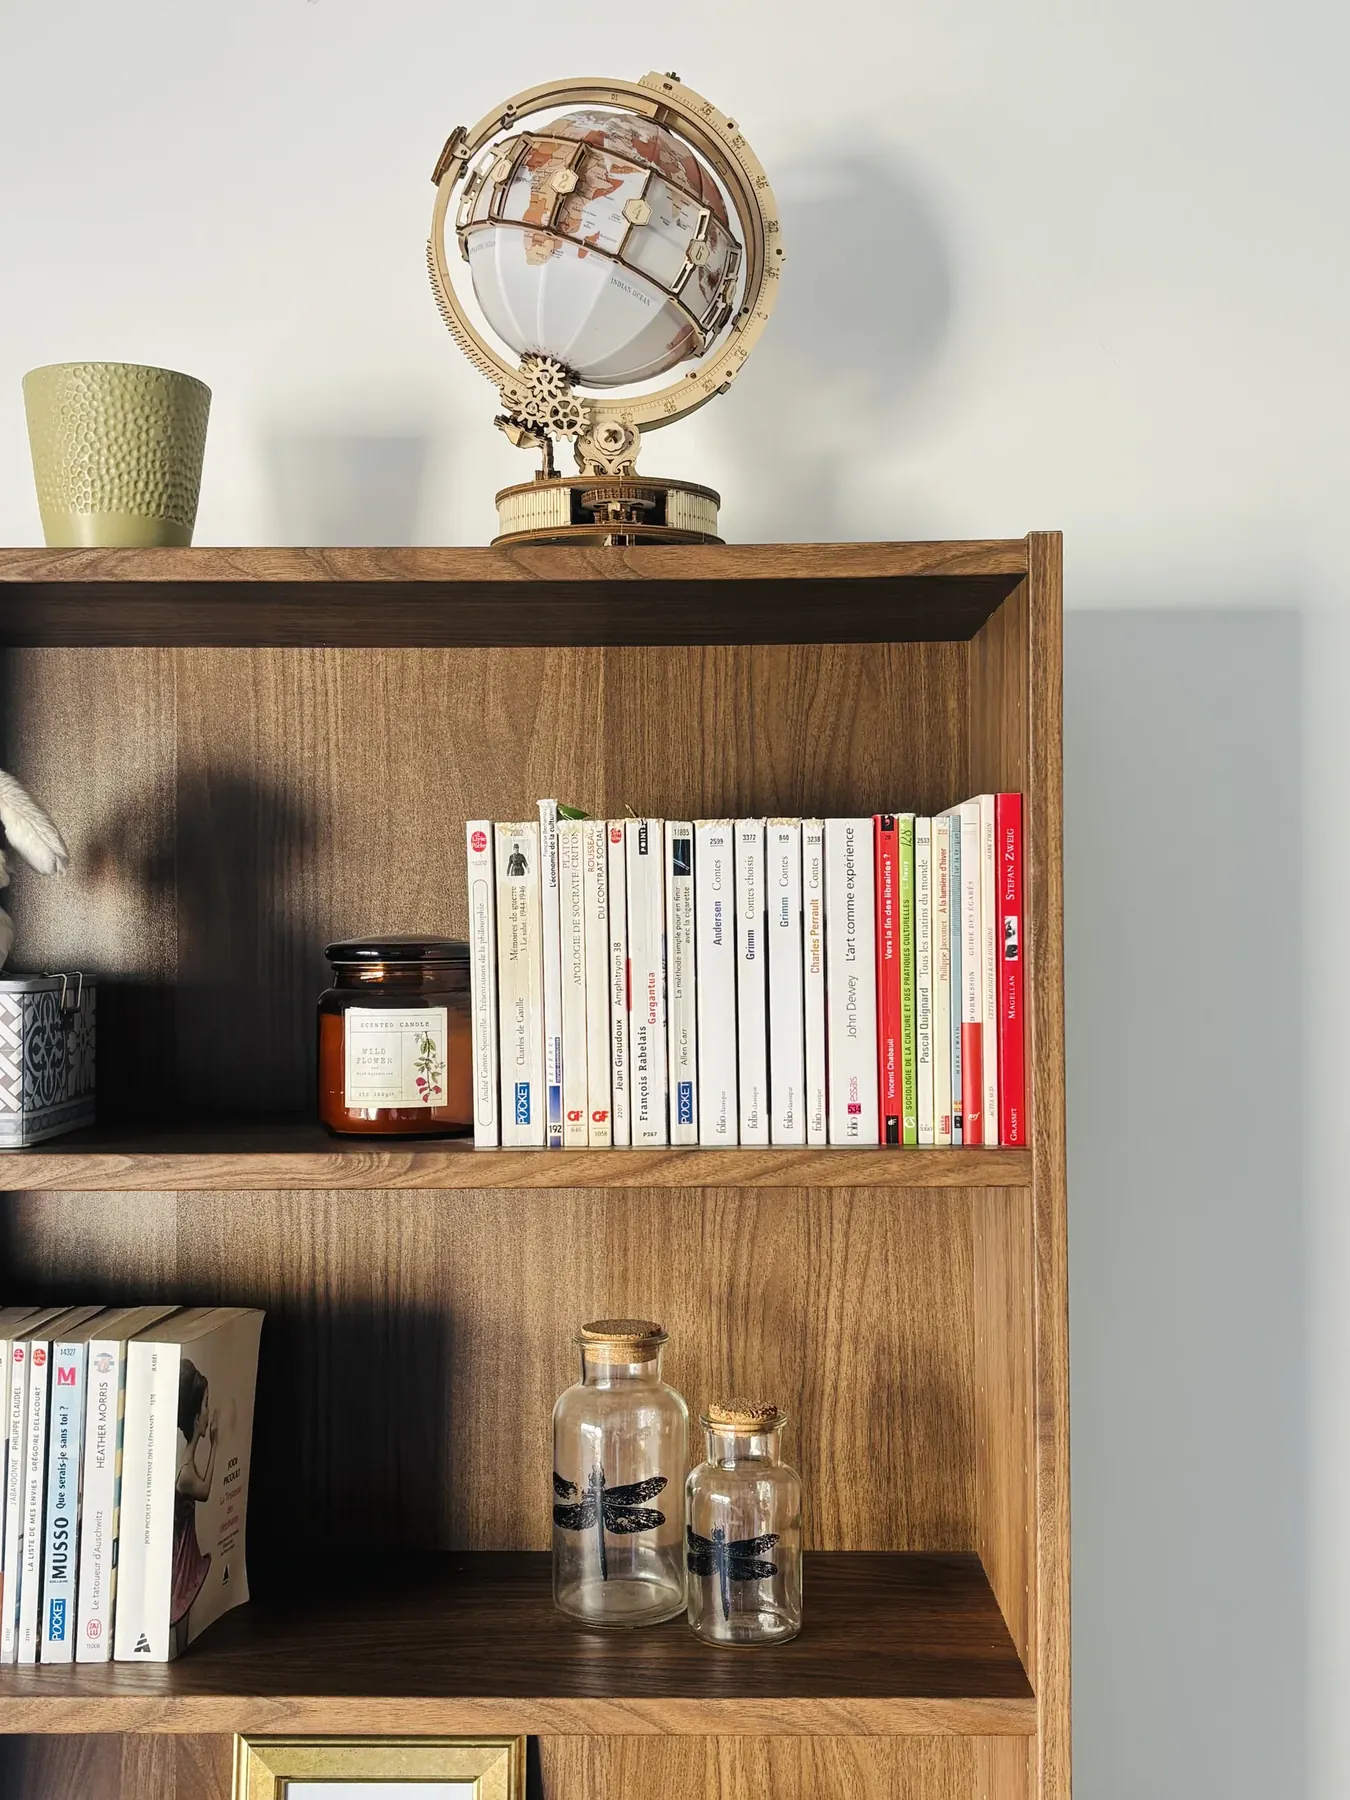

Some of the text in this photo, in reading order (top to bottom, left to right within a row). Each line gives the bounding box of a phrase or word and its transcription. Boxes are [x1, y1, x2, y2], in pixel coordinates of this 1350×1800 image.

[559, 173, 569, 189] 2
[631, 204, 642, 220] 4
[610, 277, 651, 306] INDIAN OCEAN
[900, 829, 912, 847] 128
[549, 851, 557, 887] L'économie
[596, 828, 605, 919] DU CONTRAT SOCIAL
[939, 848, 947, 871] d'hiver
[779, 856, 789, 927] Grimm Contes
[844, 828, 856, 961] L'art comme expérience
[883, 861, 891, 898] librairies
[508, 912, 517, 921] de
[675, 903, 681, 912] en
[683, 887, 691, 917] cigarette
[712, 860, 722, 945] Andersen Contes
[745, 856, 755, 960] Grimm Contes choisis
[809, 857, 819, 974] Charles Perrault Contes
[477, 903, 488, 944] philosophie
[884, 930, 892, 938] la
[509, 924, 519, 960] Mémoires
[572, 920, 581, 985] APOLOGIE DE
[614, 942, 621, 952] 38
[674, 932, 683, 954] simple
[884, 941, 892, 959] Vers
[940, 921, 948, 980] Philippe Jaccottet
[478, 954, 486, 963] de
[674, 956, 682, 987] méthode
[919, 860, 930, 1063] Pascal Quignard Tous les matins du monde
[613, 955, 623, 1006] Amphitryon
[675, 990, 682, 998] La
[1005, 828, 1018, 1141] GRASSET MAGELLAN STEFAN ZWEIG
[647, 972, 658, 1024] Gargantua
[846, 975, 858, 1038] John Dewey
[904, 1004, 910, 1012] ET
[516, 998, 525, 1065] Charles de Gaulle
[615, 1020, 623, 1067] Giraudoux
[480, 1019, 489, 1078] Comte-Sponville
[680, 1047, 688, 1065] Allen
[905, 1046, 911, 1055] LA
[905, 1058, 911, 1067] DE
[615, 1070, 623, 1091] Jean
[637, 1026, 649, 1121] François Rabelais
[887, 1071, 895, 1098] Vincent
[481, 1081, 489, 1102] André
[517, 1083, 529, 1124] POCKET
[680, 1083, 690, 1123] POCKET
[847, 1076, 858, 1137] folio essais
[548, 1125, 562, 1133] 192
[592, 1111, 609, 1122] GF
[716, 1116, 726, 1133] folio
[748, 1111, 758, 1129] folio
[783, 1111, 793, 1129] folio
[812, 1113, 822, 1131] folio
[60, 1348, 76, 1356] 14327
[57, 1367, 76, 1386] M
[12, 1387, 21, 1450] PHILIPPE CLAUDEL
[33, 1386, 41, 1431] DELACOURT
[59, 1413, 67, 1425] toi
[59, 1428, 67, 1448] sans
[96, 1382, 108, 1468] HEATHER MORRIS
[30, 1434, 39, 1472] GRÉGOIRE
[58, 1452, 68, 1489] serais-je
[56, 1492, 65, 1509] Que
[29, 1526, 35, 1536] DE
[51, 1517, 68, 1579] MUSSO
[92, 1511, 103, 1610] Le tatoueur d'Auschwitz
[28, 1562, 34, 1571] LA
[51, 1599, 63, 1640] POCKET
